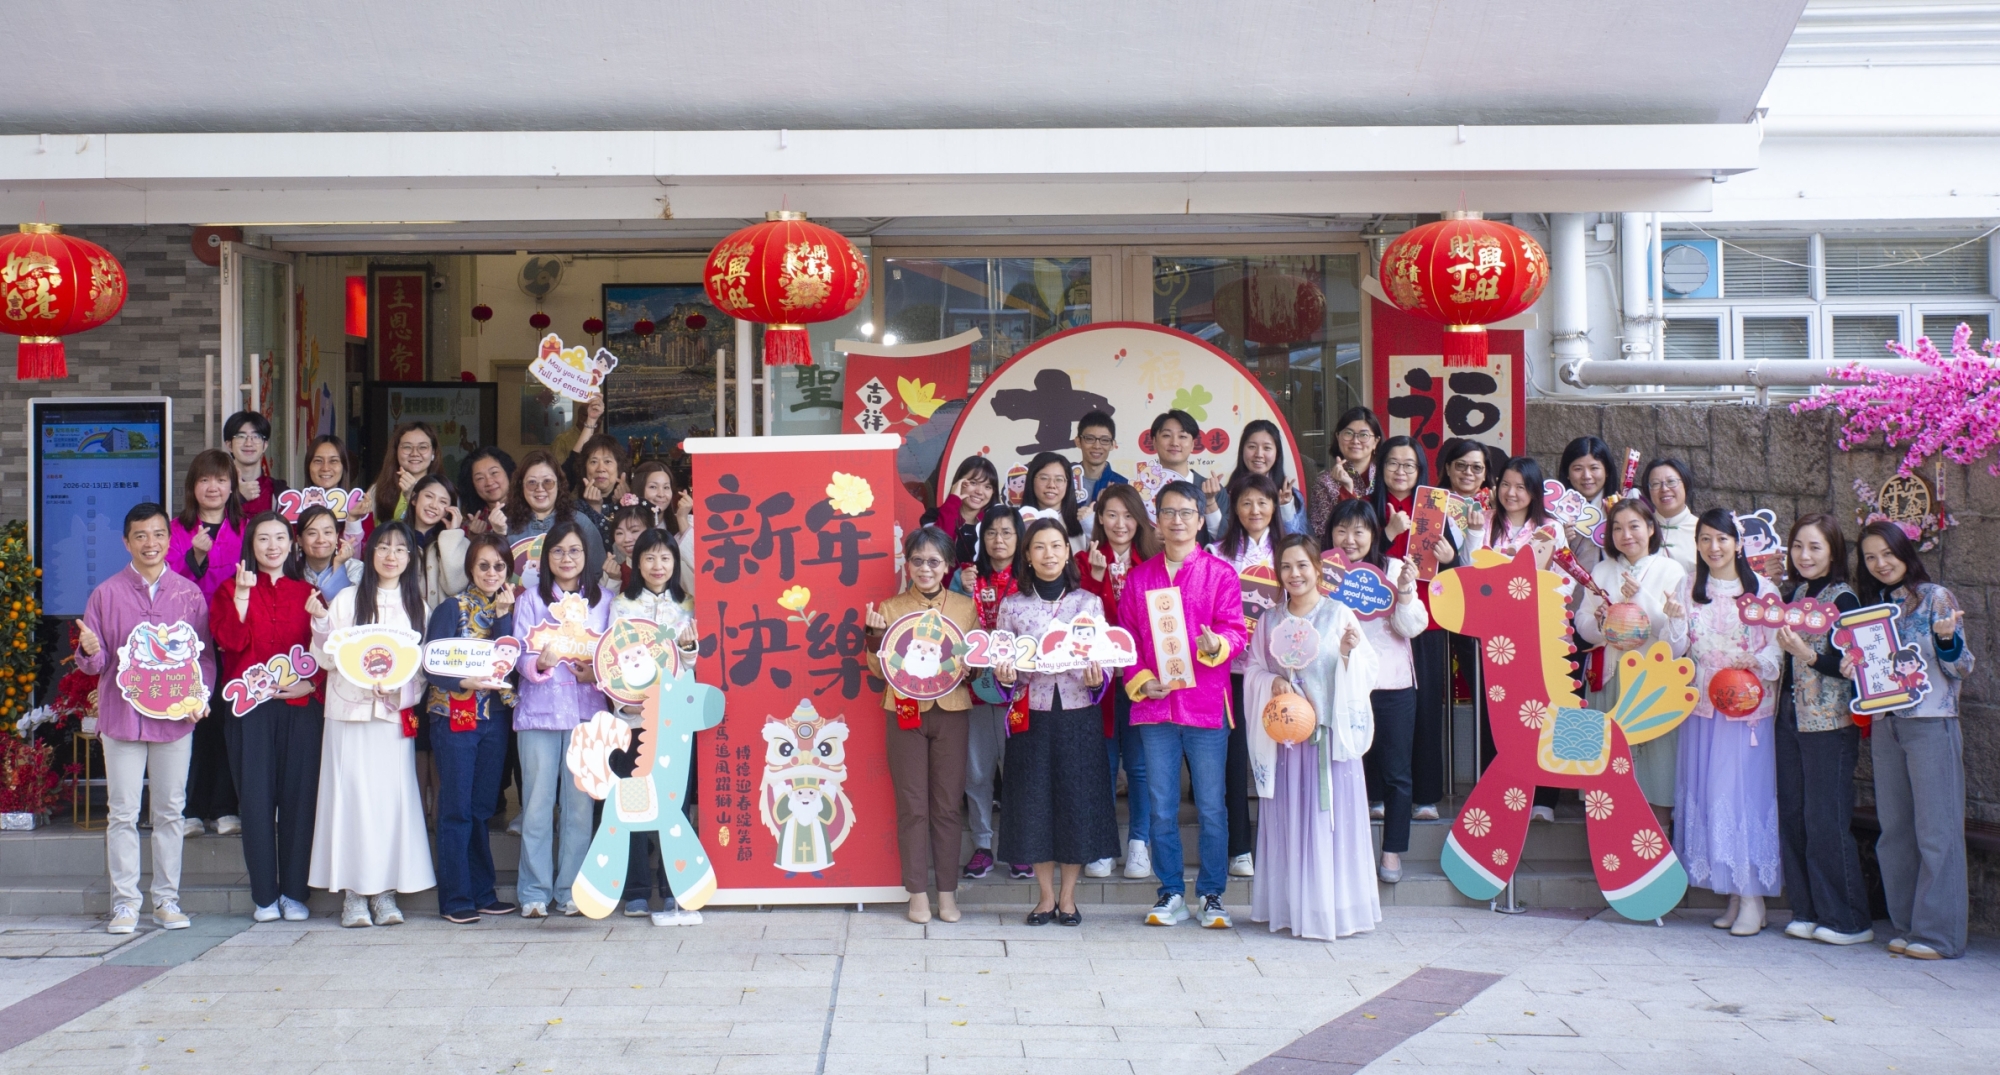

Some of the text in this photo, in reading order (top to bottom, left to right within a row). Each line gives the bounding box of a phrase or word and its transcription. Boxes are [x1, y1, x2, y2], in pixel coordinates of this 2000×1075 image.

[538, 366, 552, 379] full
[552, 377, 562, 385] of
[548, 359, 590, 385] May you feel
[862, 383, 885, 431] 吉祥
[701, 473, 888, 586] 新年
[1343, 589, 1361, 599] good
[1344, 579, 1360, 589] Wish
[1360, 585, 1374, 593] you
[1747, 608, 1822, 627] 主恩常在
[430, 648, 450, 657] May
[471, 648, 491, 656] Lord
[698, 600, 886, 699] 快樂
[430, 658, 440, 666] be
[465, 660, 485, 668] you!
[1038, 662, 1054, 670] May
[1056, 661, 1071, 670] your
[1118, 655, 1134, 664] true!
[130, 683, 202, 699] 合家歡樂
[715, 713, 732, 824] 馬追風躍獅山
